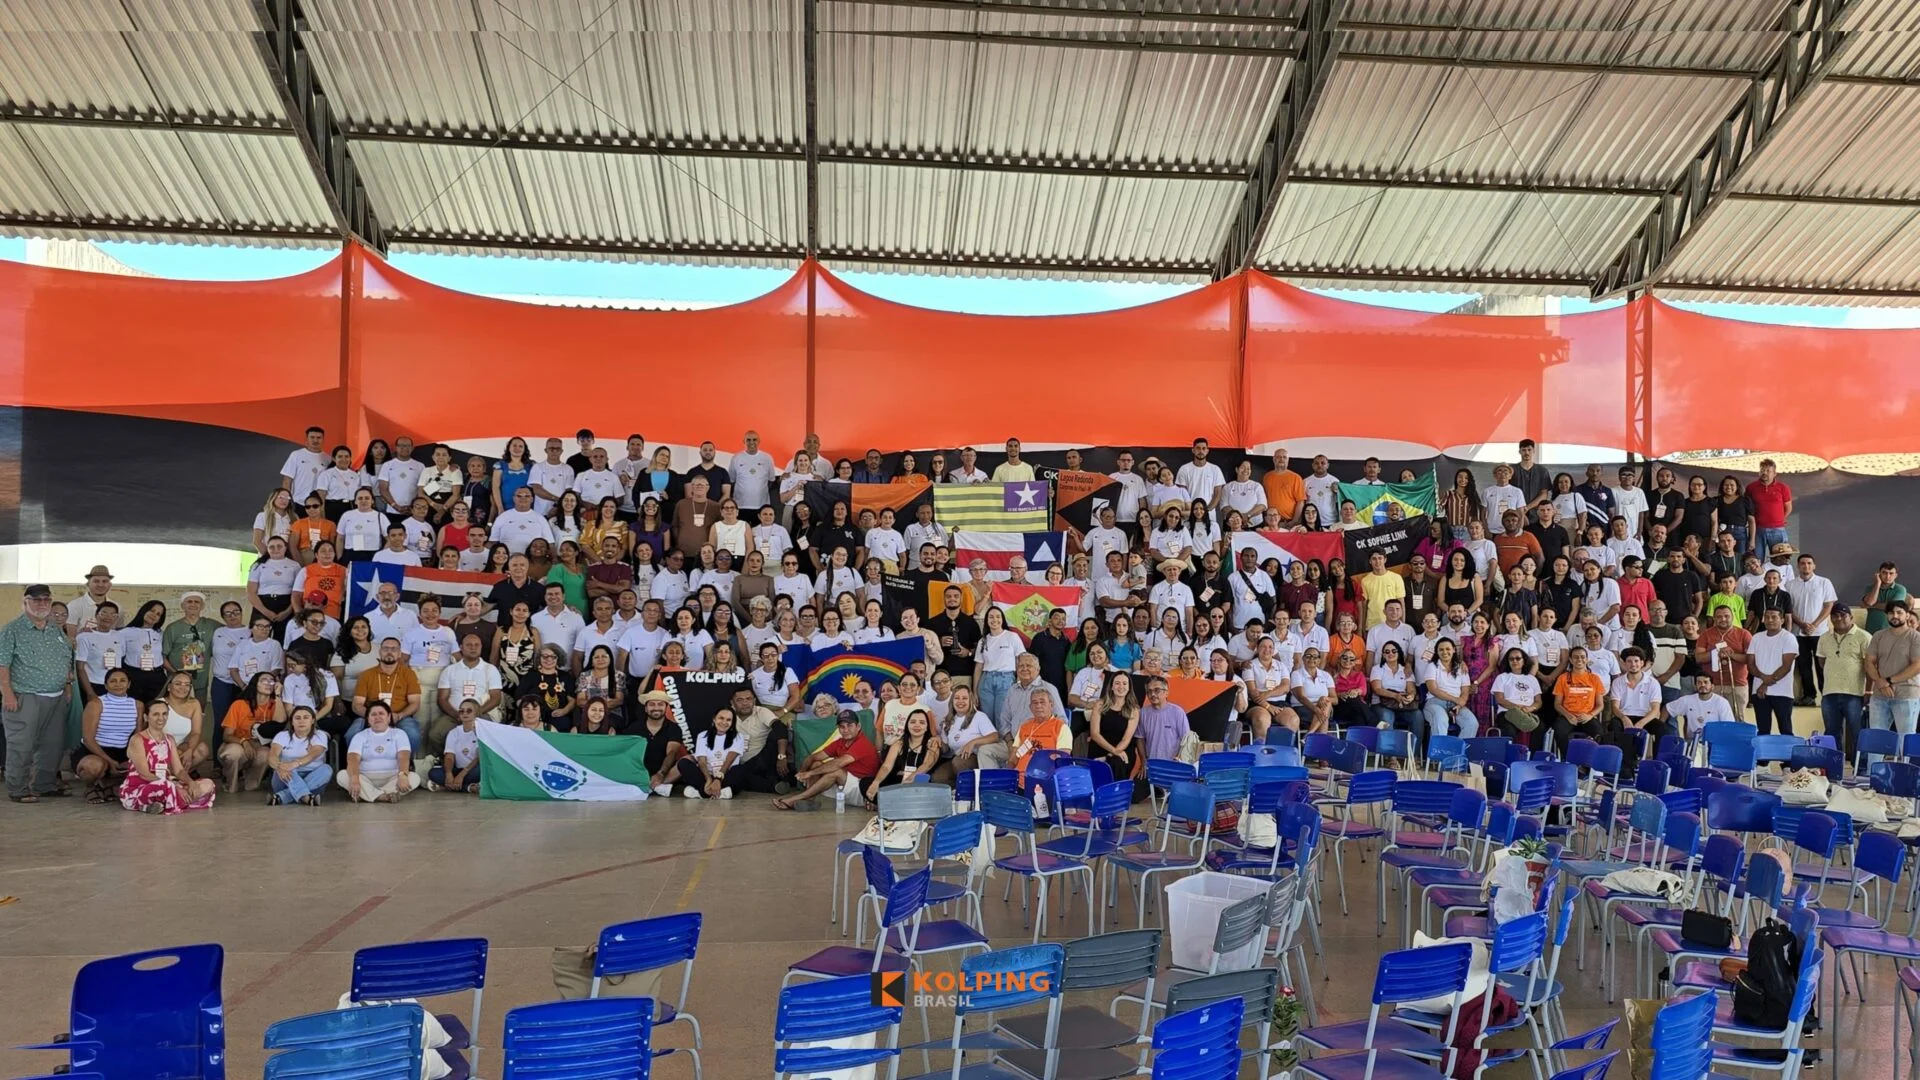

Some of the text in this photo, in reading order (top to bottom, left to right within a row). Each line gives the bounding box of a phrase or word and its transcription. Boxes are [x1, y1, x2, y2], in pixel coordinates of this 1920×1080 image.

[1356, 529, 1408, 549] CK SOPHIE LINK
[685, 671, 745, 683] KOLPING
